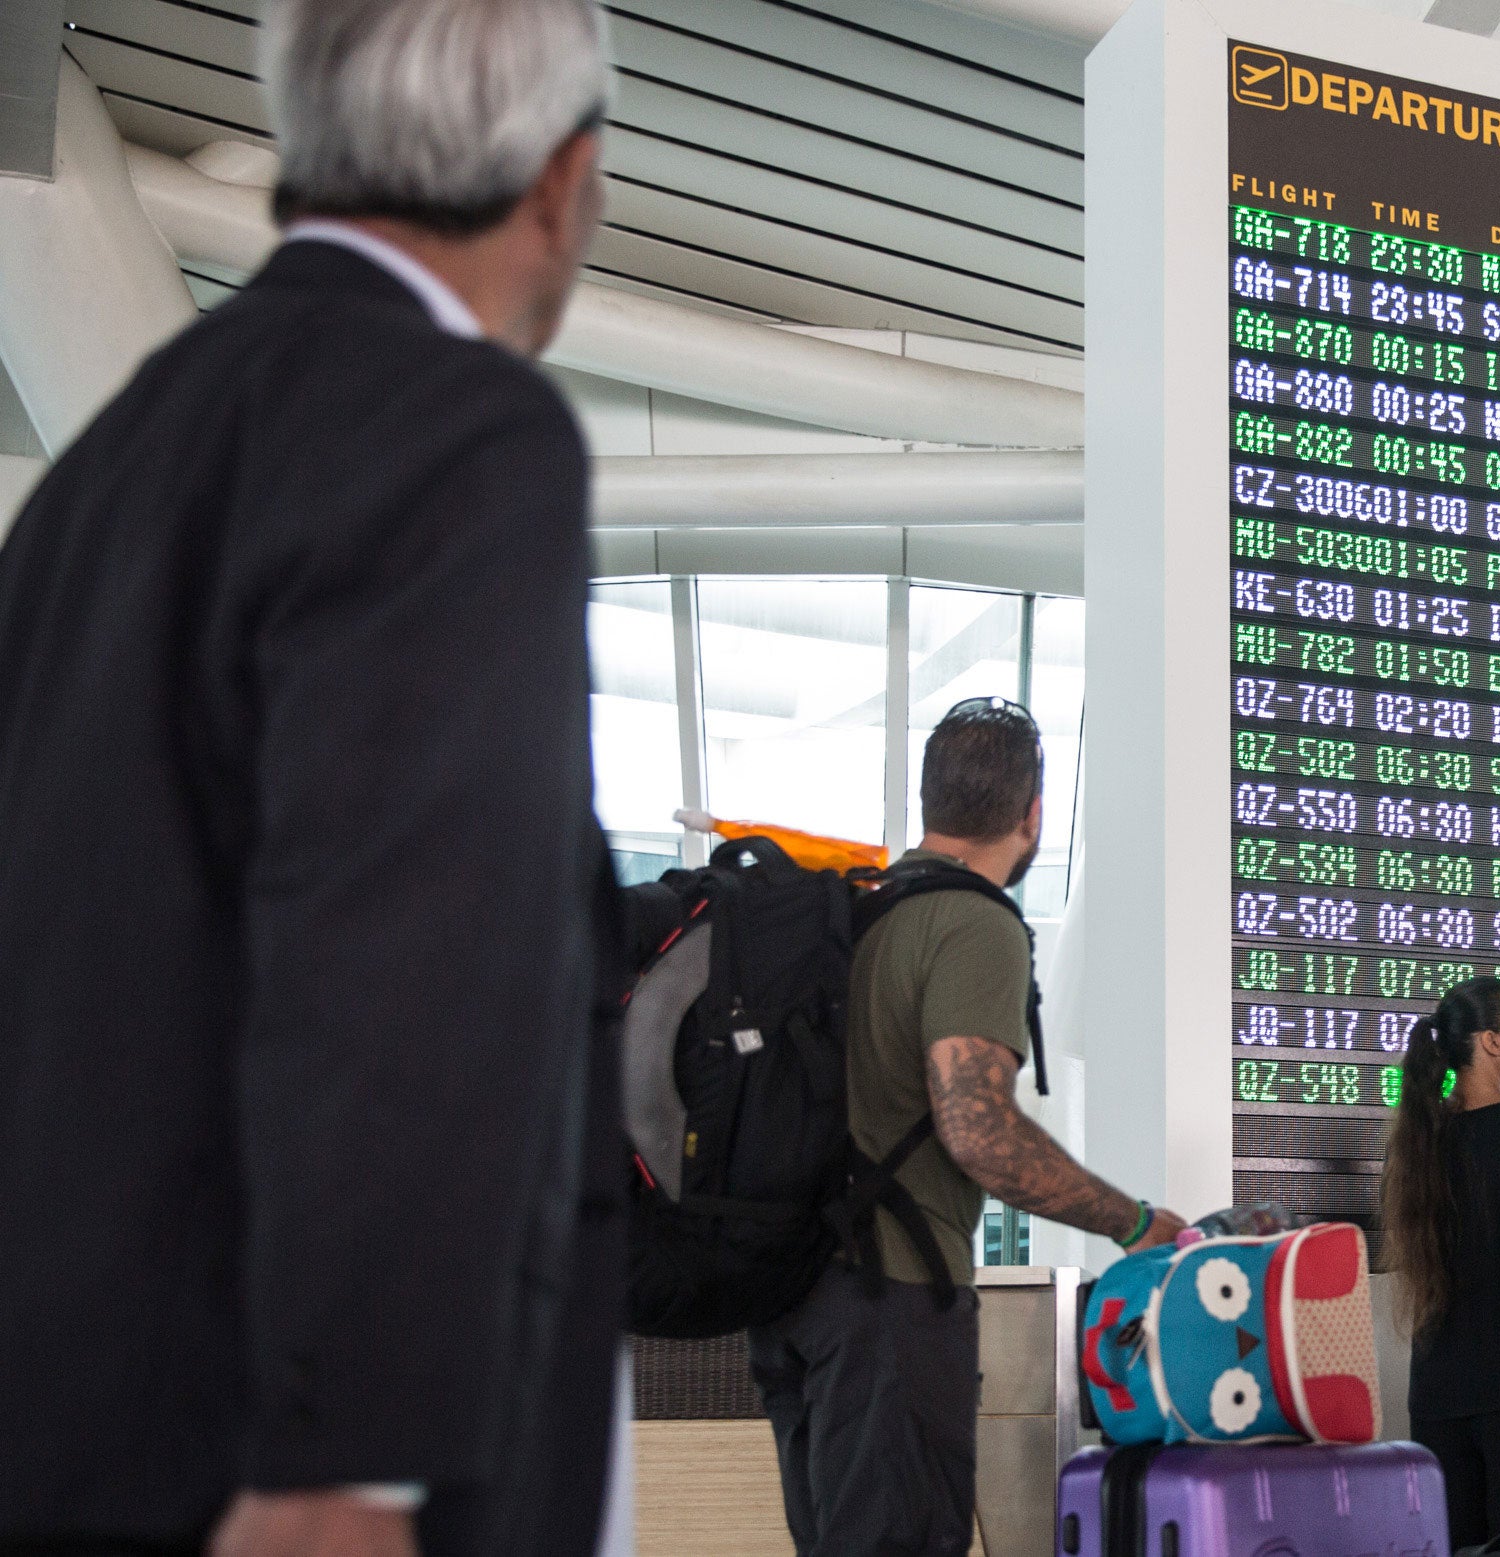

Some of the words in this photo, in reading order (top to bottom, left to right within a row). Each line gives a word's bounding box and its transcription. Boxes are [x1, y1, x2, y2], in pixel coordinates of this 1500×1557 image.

[1233, 174, 1335, 210] FLIGHT
[1372, 202, 1439, 231] TIME
[1235, 207, 1350, 264] GA-718
[1371, 233, 1463, 285] 23:30
[1235, 257, 1351, 314] GA-714
[1372, 282, 1464, 334] 23:45
[1236, 308, 1352, 365] GA-870
[1373, 333, 1465, 384] 00:15
[1236, 360, 1352, 415] GA-880
[1373, 383, 1465, 434] 00:25
[1236, 412, 1352, 467] GA-882
[1374, 434, 1466, 484] 00:45
[1236, 571, 1354, 622] KE-630
[1375, 590, 1468, 636] 01:25
[1237, 624, 1354, 674] MU-782
[1376, 642, 1469, 687] 01:50
[1237, 678, 1354, 727] OZ-764
[1376, 693, 1470, 739] 02:20
[1237, 732, 1356, 780] QZ-502
[1377, 746, 1471, 791] 06:30
[1238, 784, 1356, 833] QZ-550
[1377, 797, 1472, 843] 06:30
[1237, 839, 1356, 887] QZ-534
[1378, 850, 1472, 895] 06:30
[1238, 893, 1358, 941] QZ-502
[1378, 903, 1474, 948] 06:30
[1238, 950, 1358, 994] JQ-117
[1238, 1006, 1358, 1049] JQ-117
[1238, 1061, 1359, 1104] QZ-548
